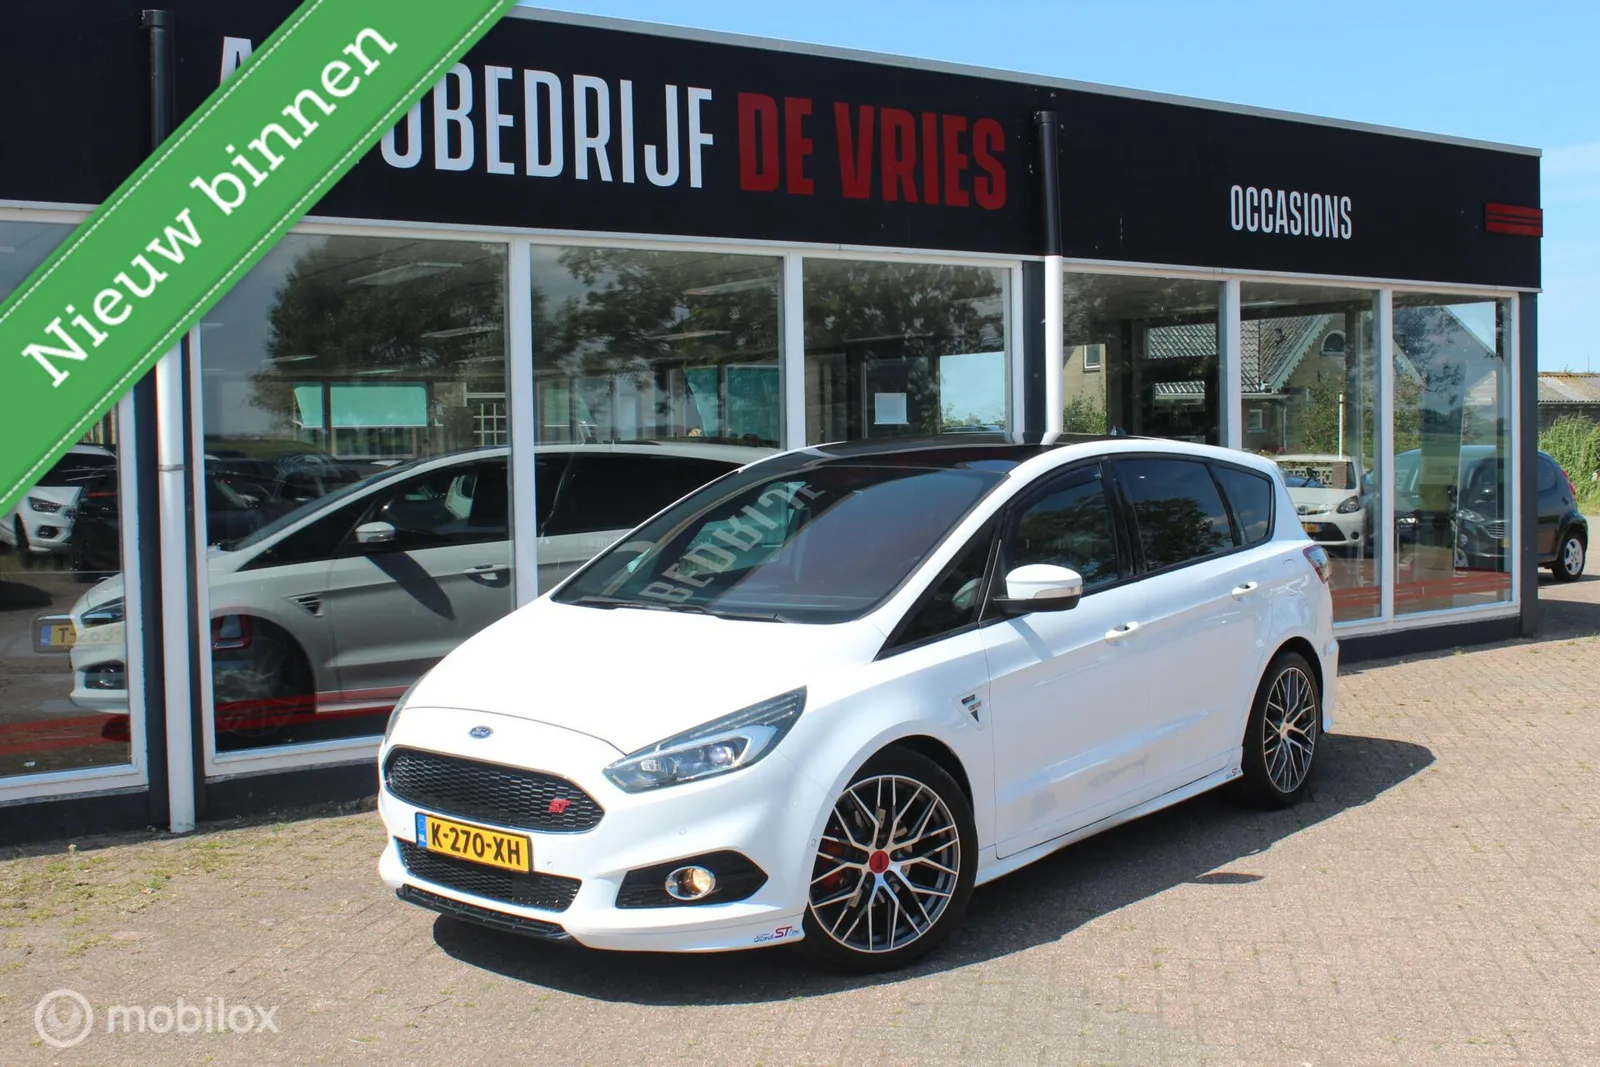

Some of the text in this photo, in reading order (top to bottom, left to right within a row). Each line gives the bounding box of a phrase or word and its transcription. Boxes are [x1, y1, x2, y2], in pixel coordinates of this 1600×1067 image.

[737, 91, 815, 196] DE
[833, 101, 1007, 211] VRIES
[1230, 184, 1353, 241] OCCASIONS
[431, 822, 521, 866] K-270-XH
